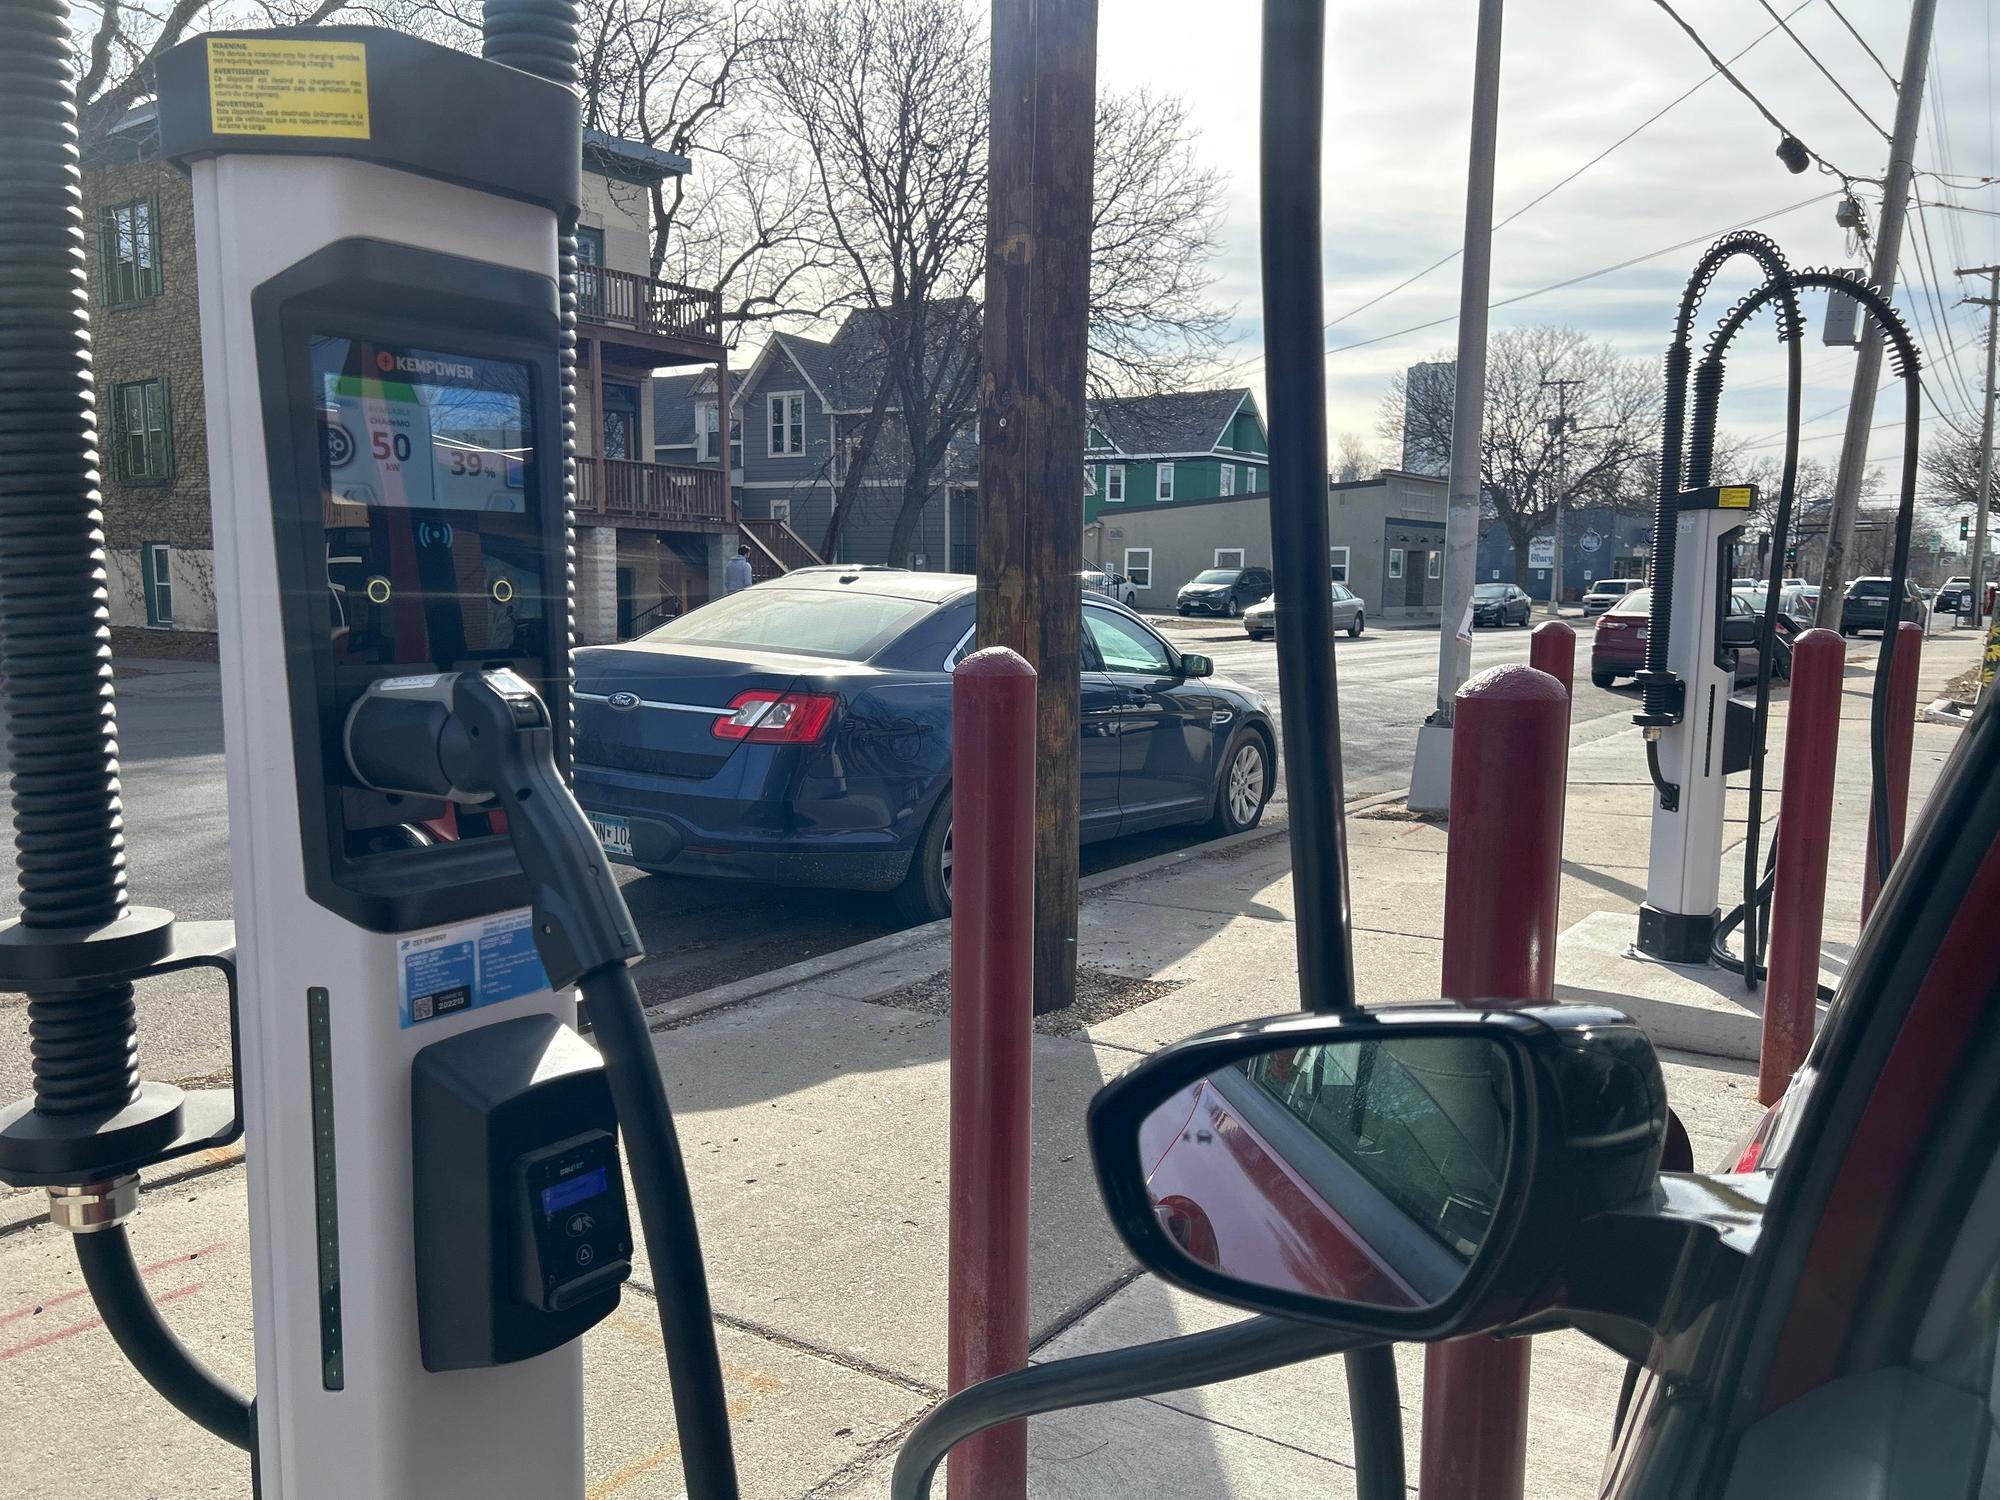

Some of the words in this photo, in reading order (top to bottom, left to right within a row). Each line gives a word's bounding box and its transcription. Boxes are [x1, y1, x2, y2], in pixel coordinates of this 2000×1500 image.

[396, 355, 474, 380] KEMPOWER
[373, 432, 411, 461] 50
[386, 463, 400, 472] kW
[451, 451, 482, 476] 39
[484, 466, 496, 478] %
[611, 694, 631, 706] Ford
